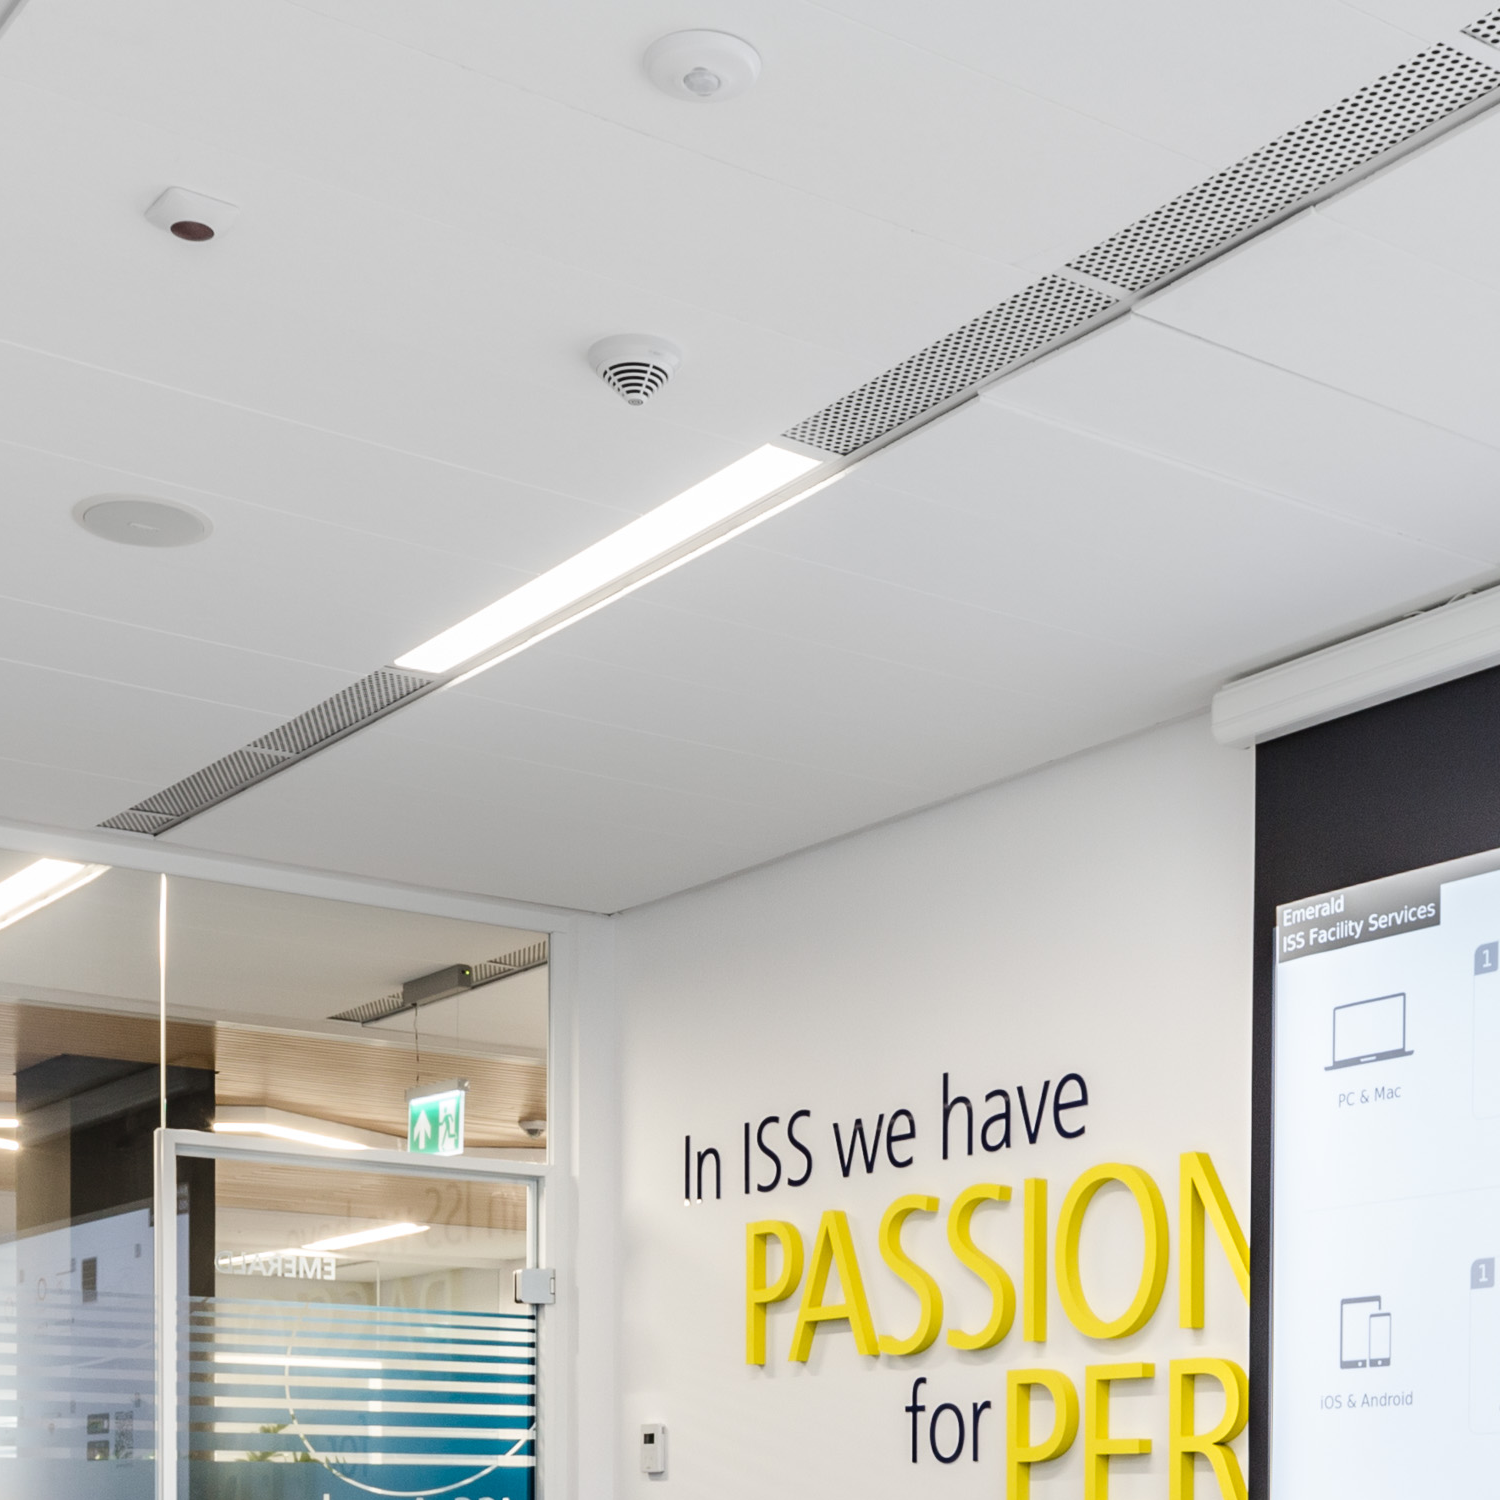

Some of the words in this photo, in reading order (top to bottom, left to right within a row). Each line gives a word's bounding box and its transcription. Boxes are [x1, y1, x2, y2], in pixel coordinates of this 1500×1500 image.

[1283, 894, 1345, 926] Emerald
[1283, 931, 1305, 953] ISS
[1309, 919, 1364, 946] Facility
[1368, 902, 1436, 931] Services
[1481, 949, 1493, 968] 1
[1338, 1093, 1357, 1108] PC
[1359, 1090, 1370, 1104] &
[1375, 1086, 1401, 1102] Mac
[684, 1134, 722, 1200] In
[743, 1109, 813, 1195] ISS
[832, 1105, 916, 1178] we
[941, 1071, 1089, 1161] have
[745, 1150, 1251, 1367] PASSION
[1478, 1264, 1489, 1283] 1
[1320, 1393, 1344, 1411] iOS
[1347, 1393, 1357, 1410] &
[1361, 1391, 1414, 1410] Android
[904, 1376, 991, 1464] for
